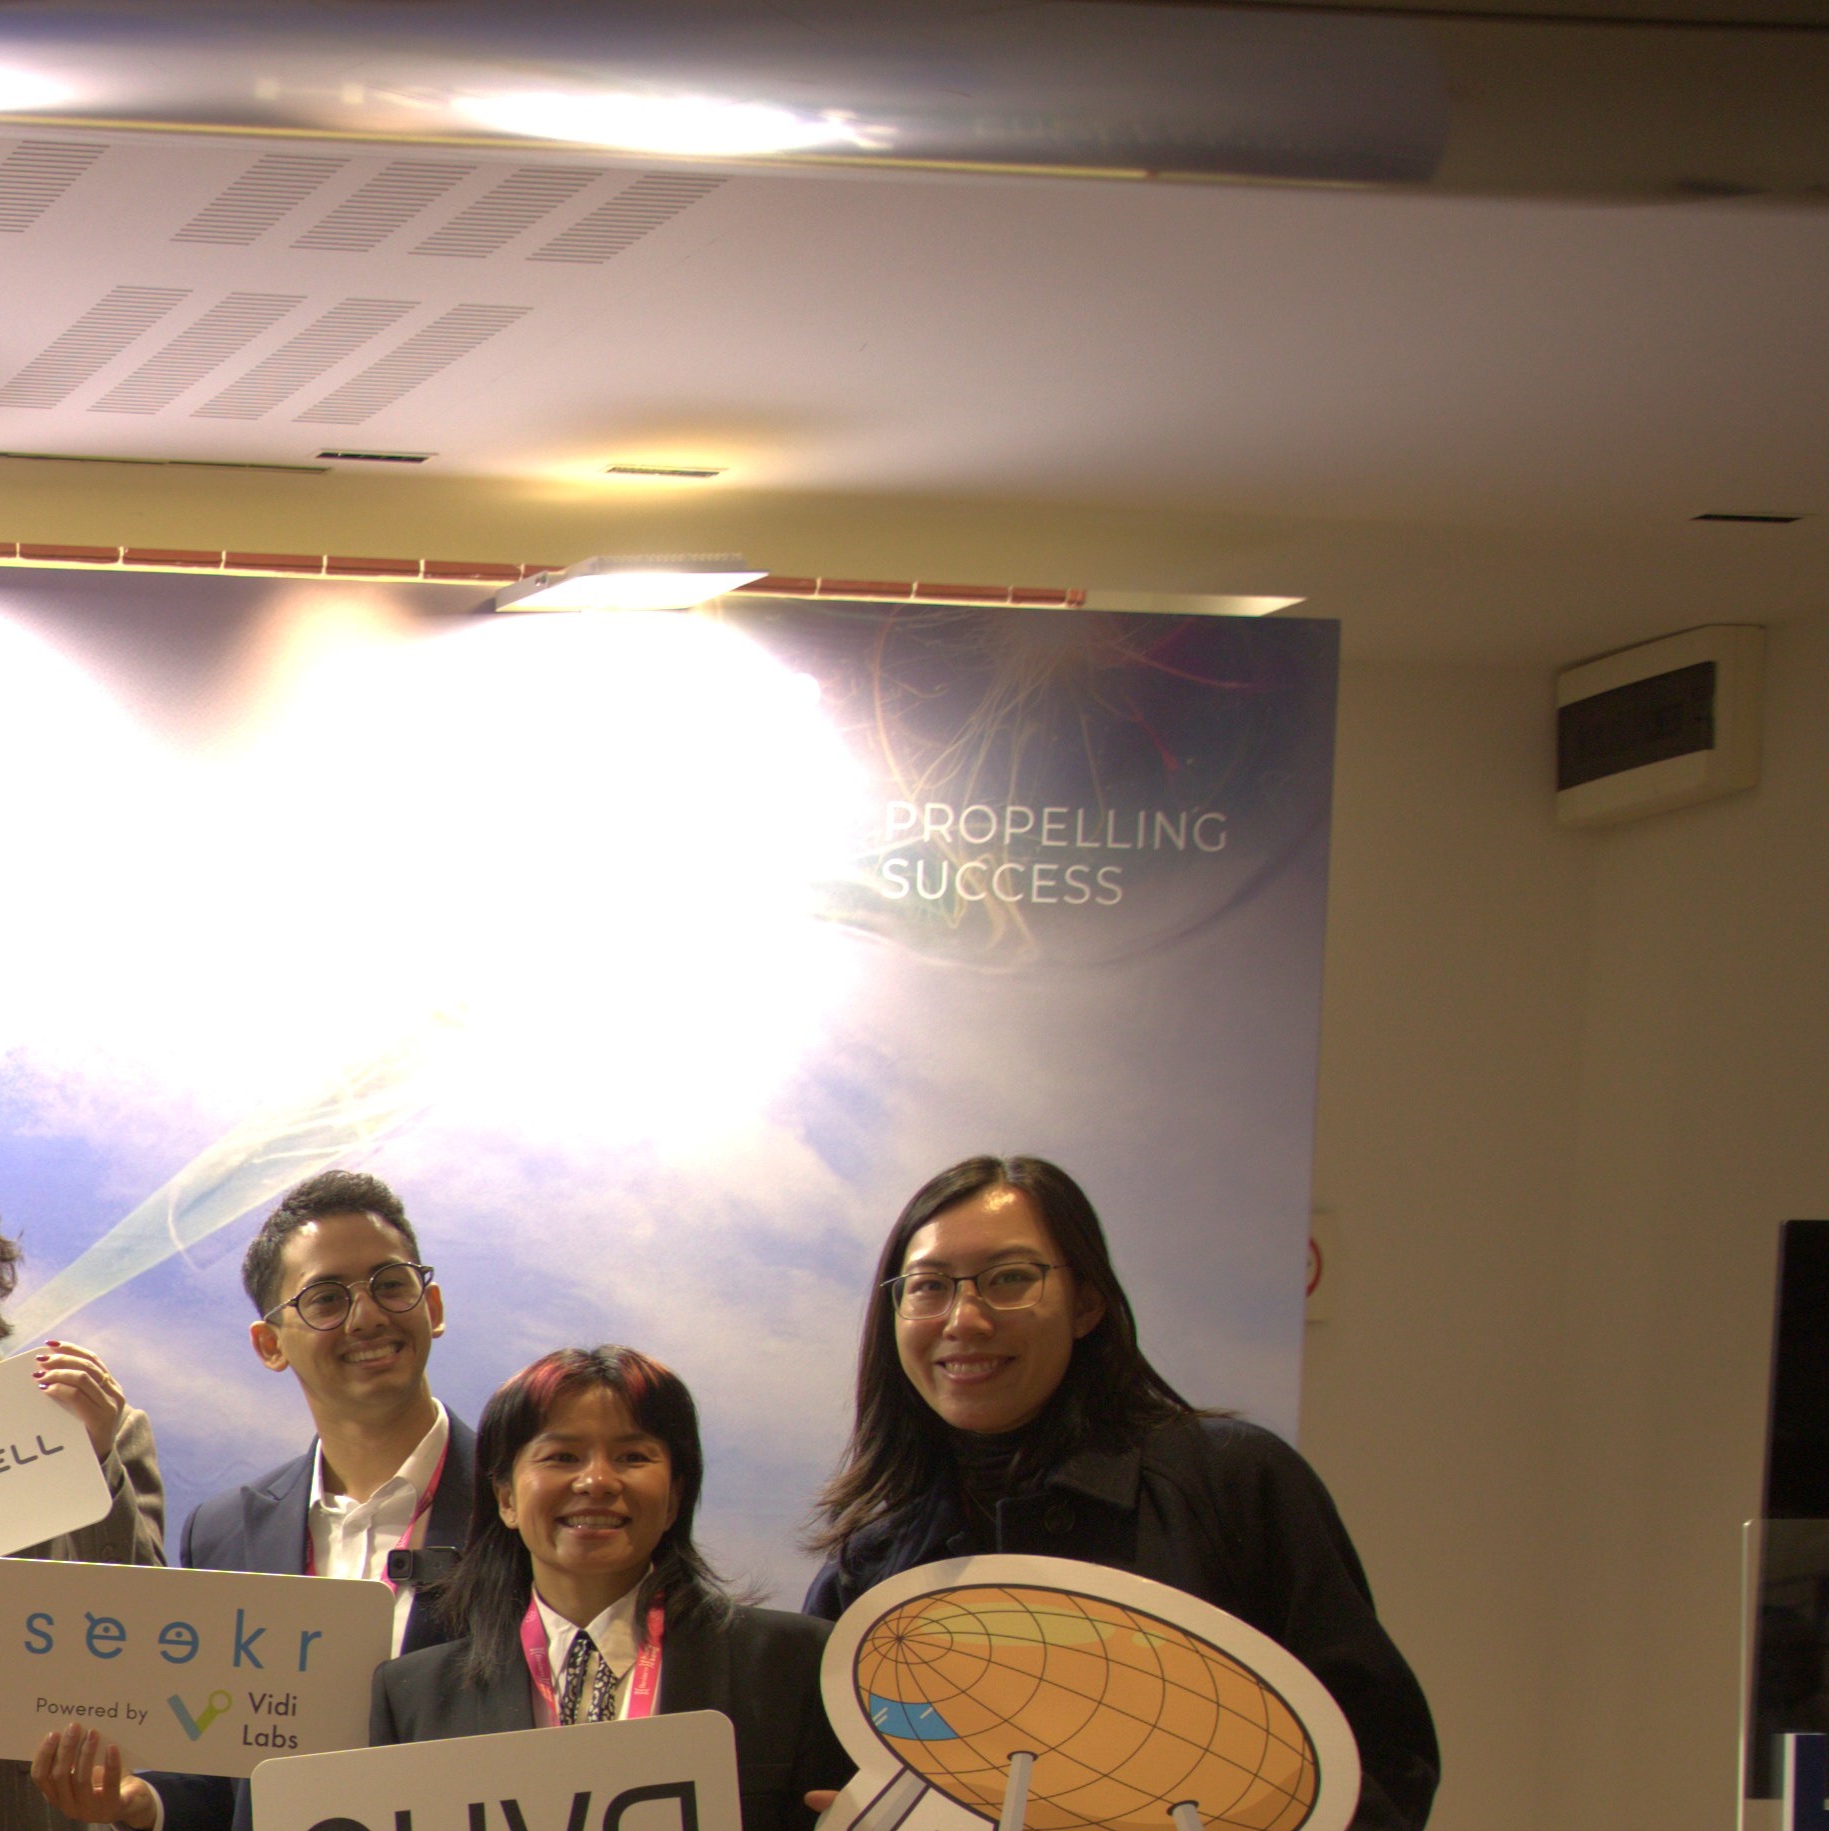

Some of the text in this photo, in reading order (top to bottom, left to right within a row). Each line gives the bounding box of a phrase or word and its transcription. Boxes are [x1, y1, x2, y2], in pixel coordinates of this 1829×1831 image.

[885, 802, 1227, 852] PROPELLING
[881, 859, 1124, 905] SUCCESS
[23, 1608, 322, 1673] seekr
[35, 1697, 149, 1726] Powered by
[248, 1690, 298, 1718] Vidi
[242, 1723, 299, 1750] Labs
